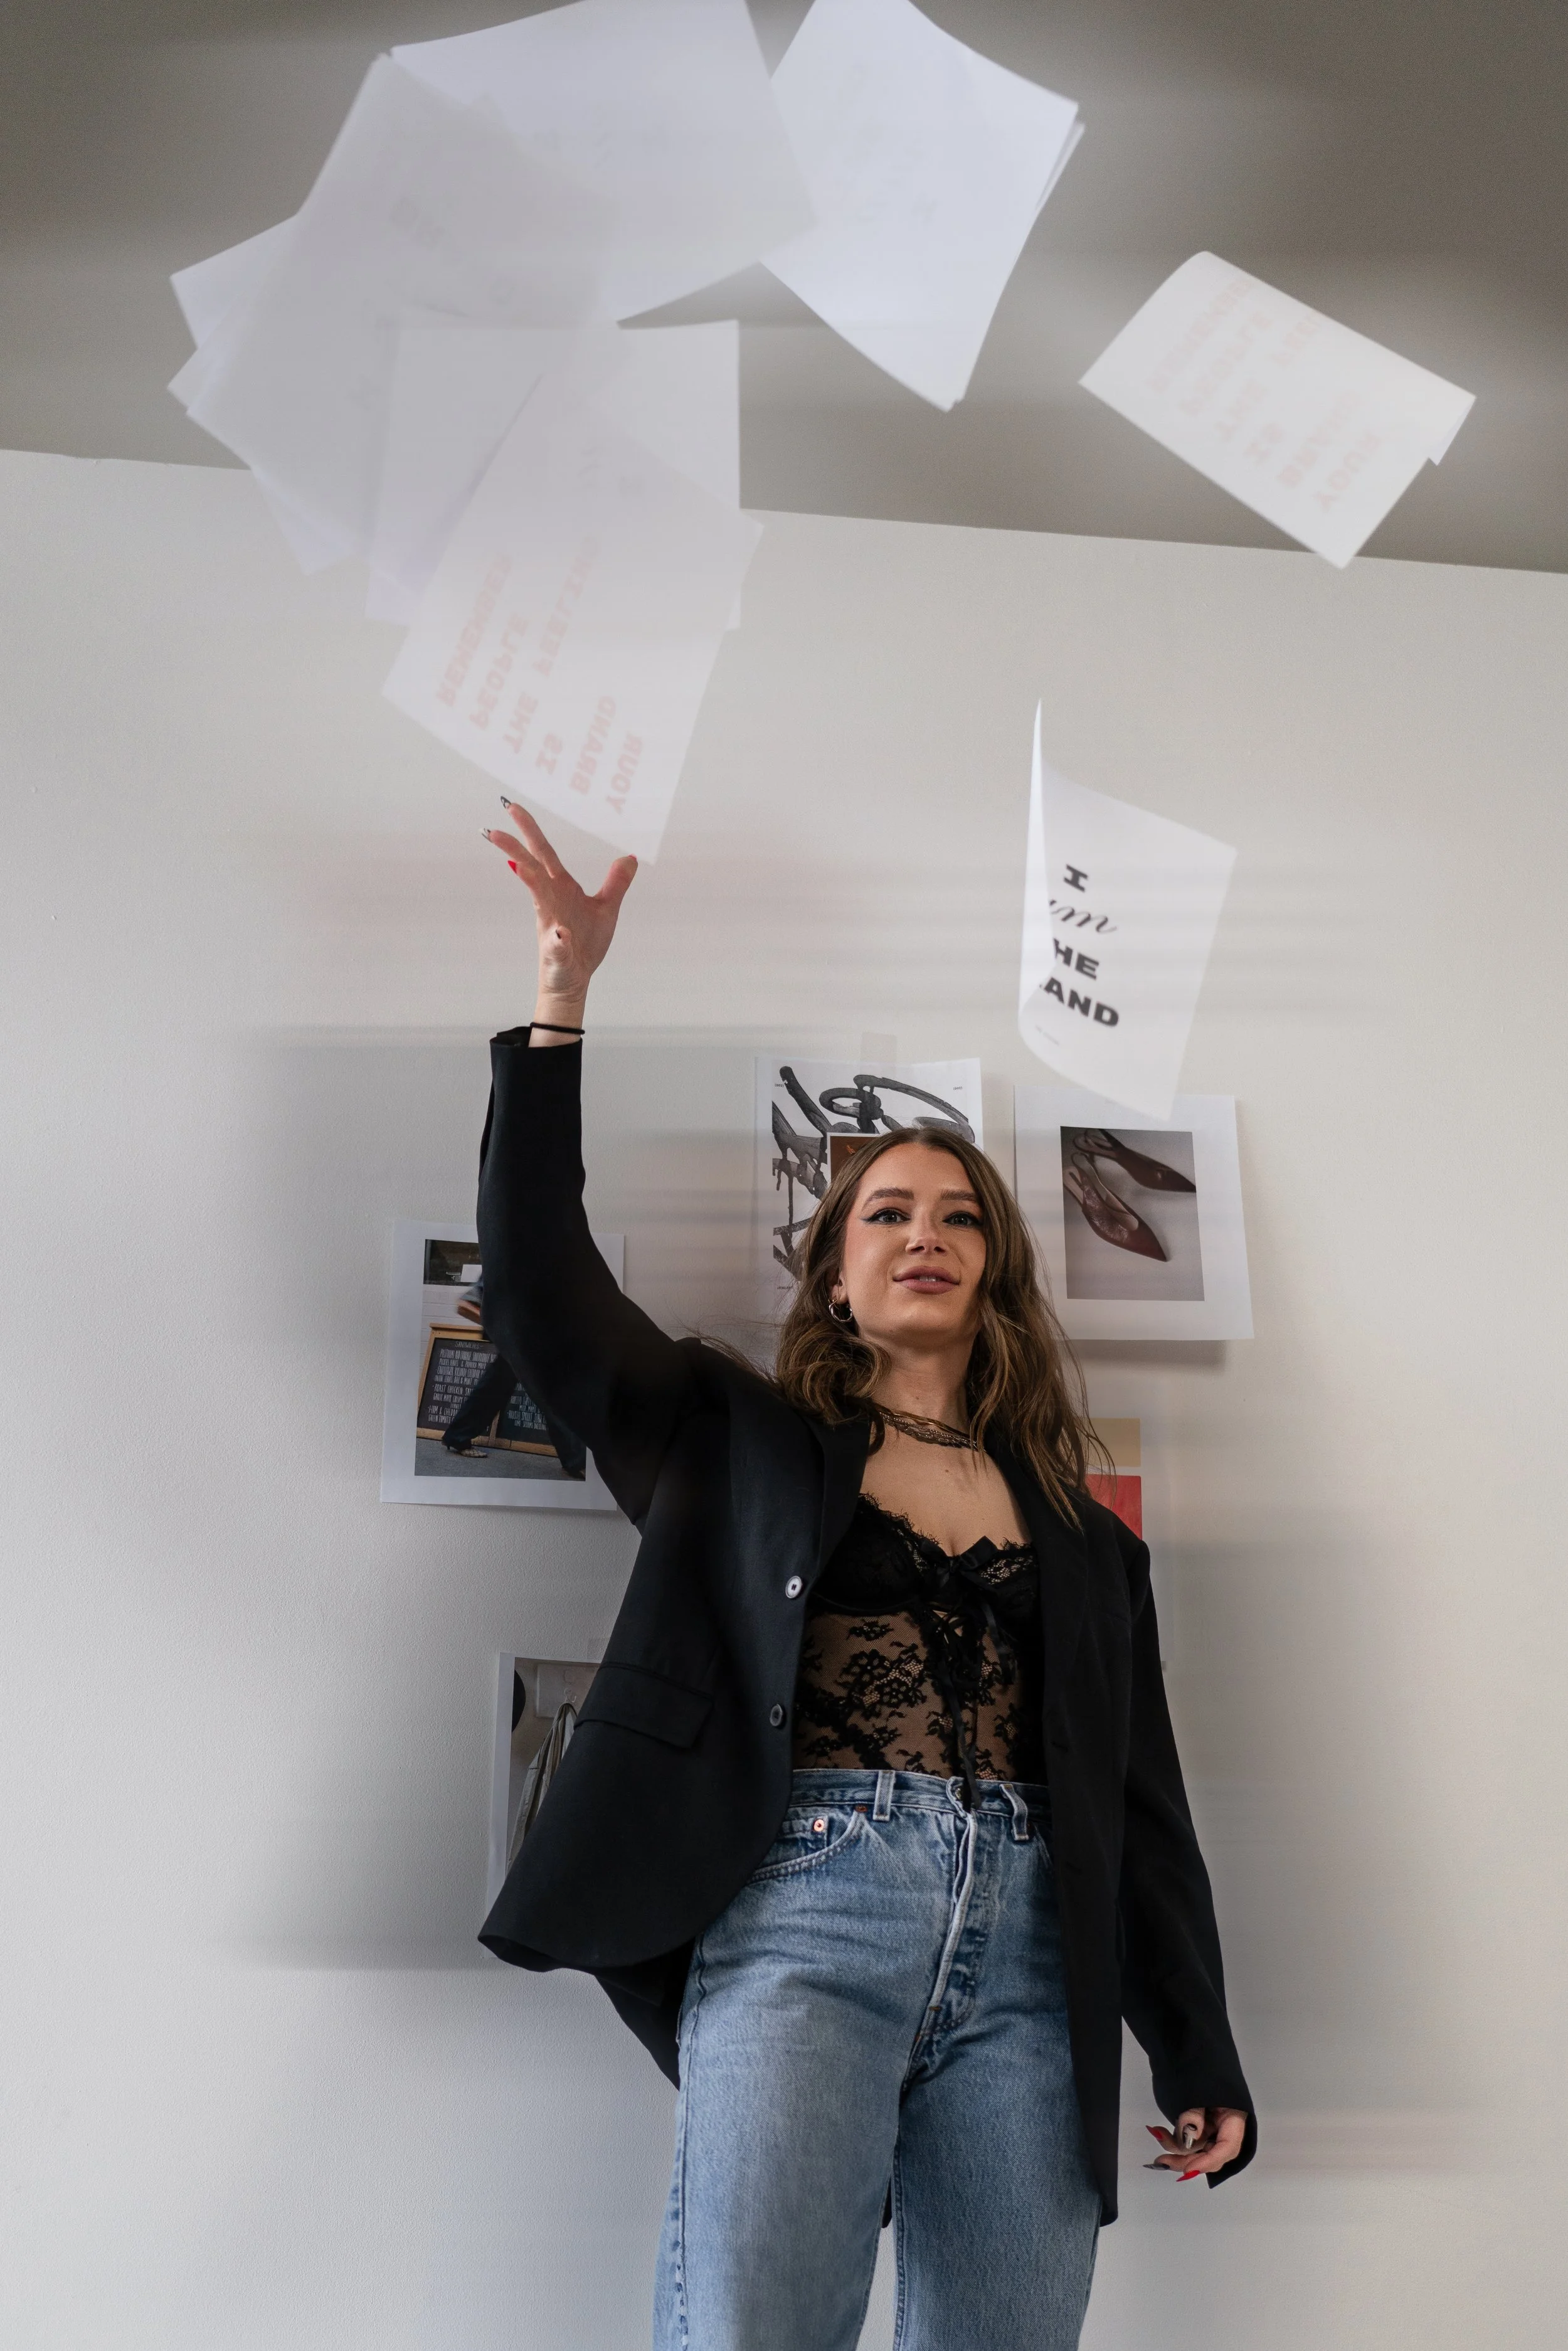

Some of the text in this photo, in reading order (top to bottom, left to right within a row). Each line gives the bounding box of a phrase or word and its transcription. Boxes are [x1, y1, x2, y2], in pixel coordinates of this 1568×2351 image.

[1064, 863, 1088, 892] I
[1053, 937, 1099, 980] HE
[1039, 976, 1119, 1027] AND
